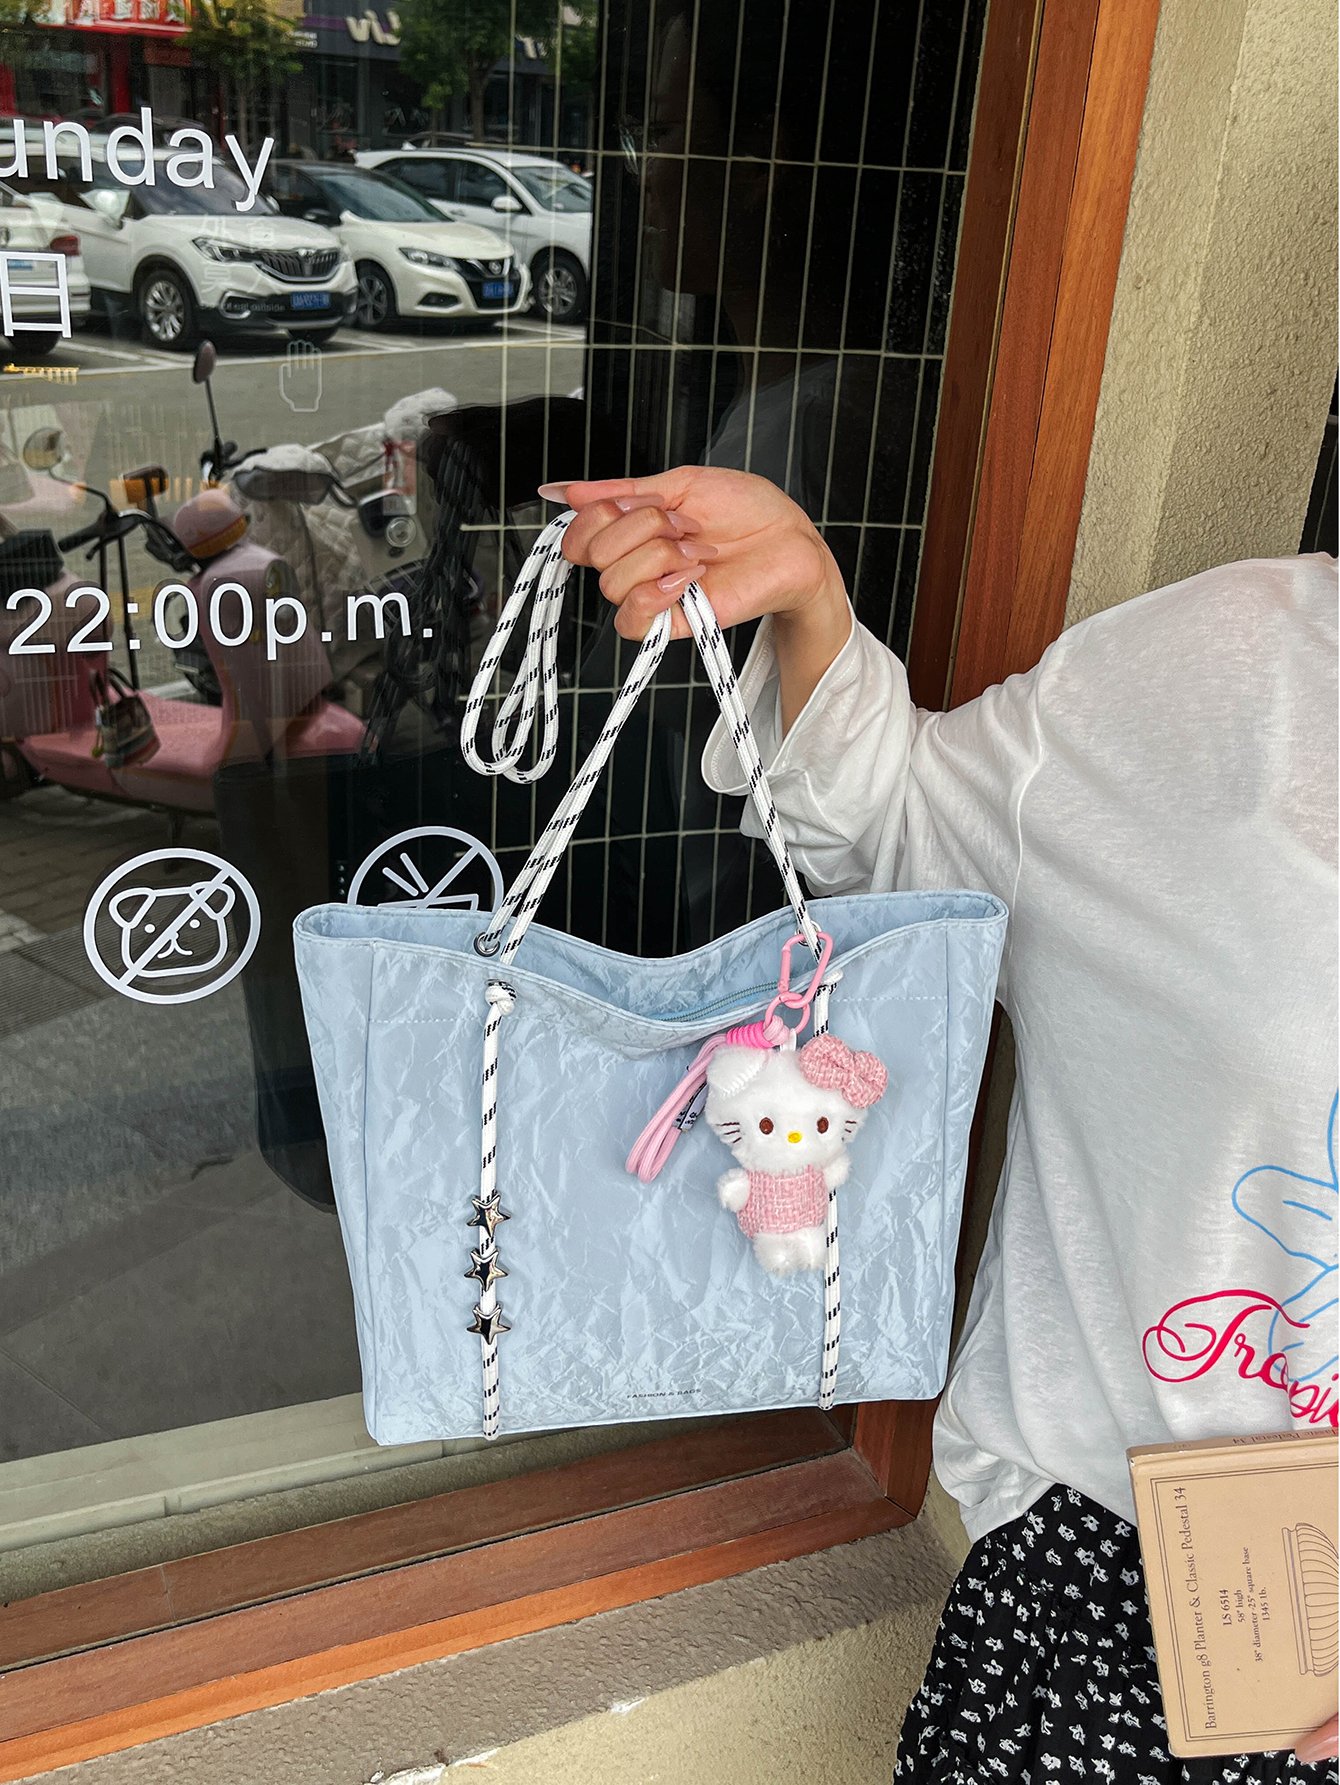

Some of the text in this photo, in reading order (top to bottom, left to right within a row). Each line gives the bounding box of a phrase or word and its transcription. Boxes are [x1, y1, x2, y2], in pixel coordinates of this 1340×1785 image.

[1242, 1547, 1250, 1565] base
[1246, 1566, 1255, 1593] square
[1173, 1486, 1217, 1729] Barrington g8 Planter & Classic Pedestal 34
[1219, 1588, 1232, 1626] LS 6514
[1234, 1589, 1244, 1608] high
[1261, 1602, 1270, 1621] 1345
[1251, 1612, 1261, 1648] diameter
